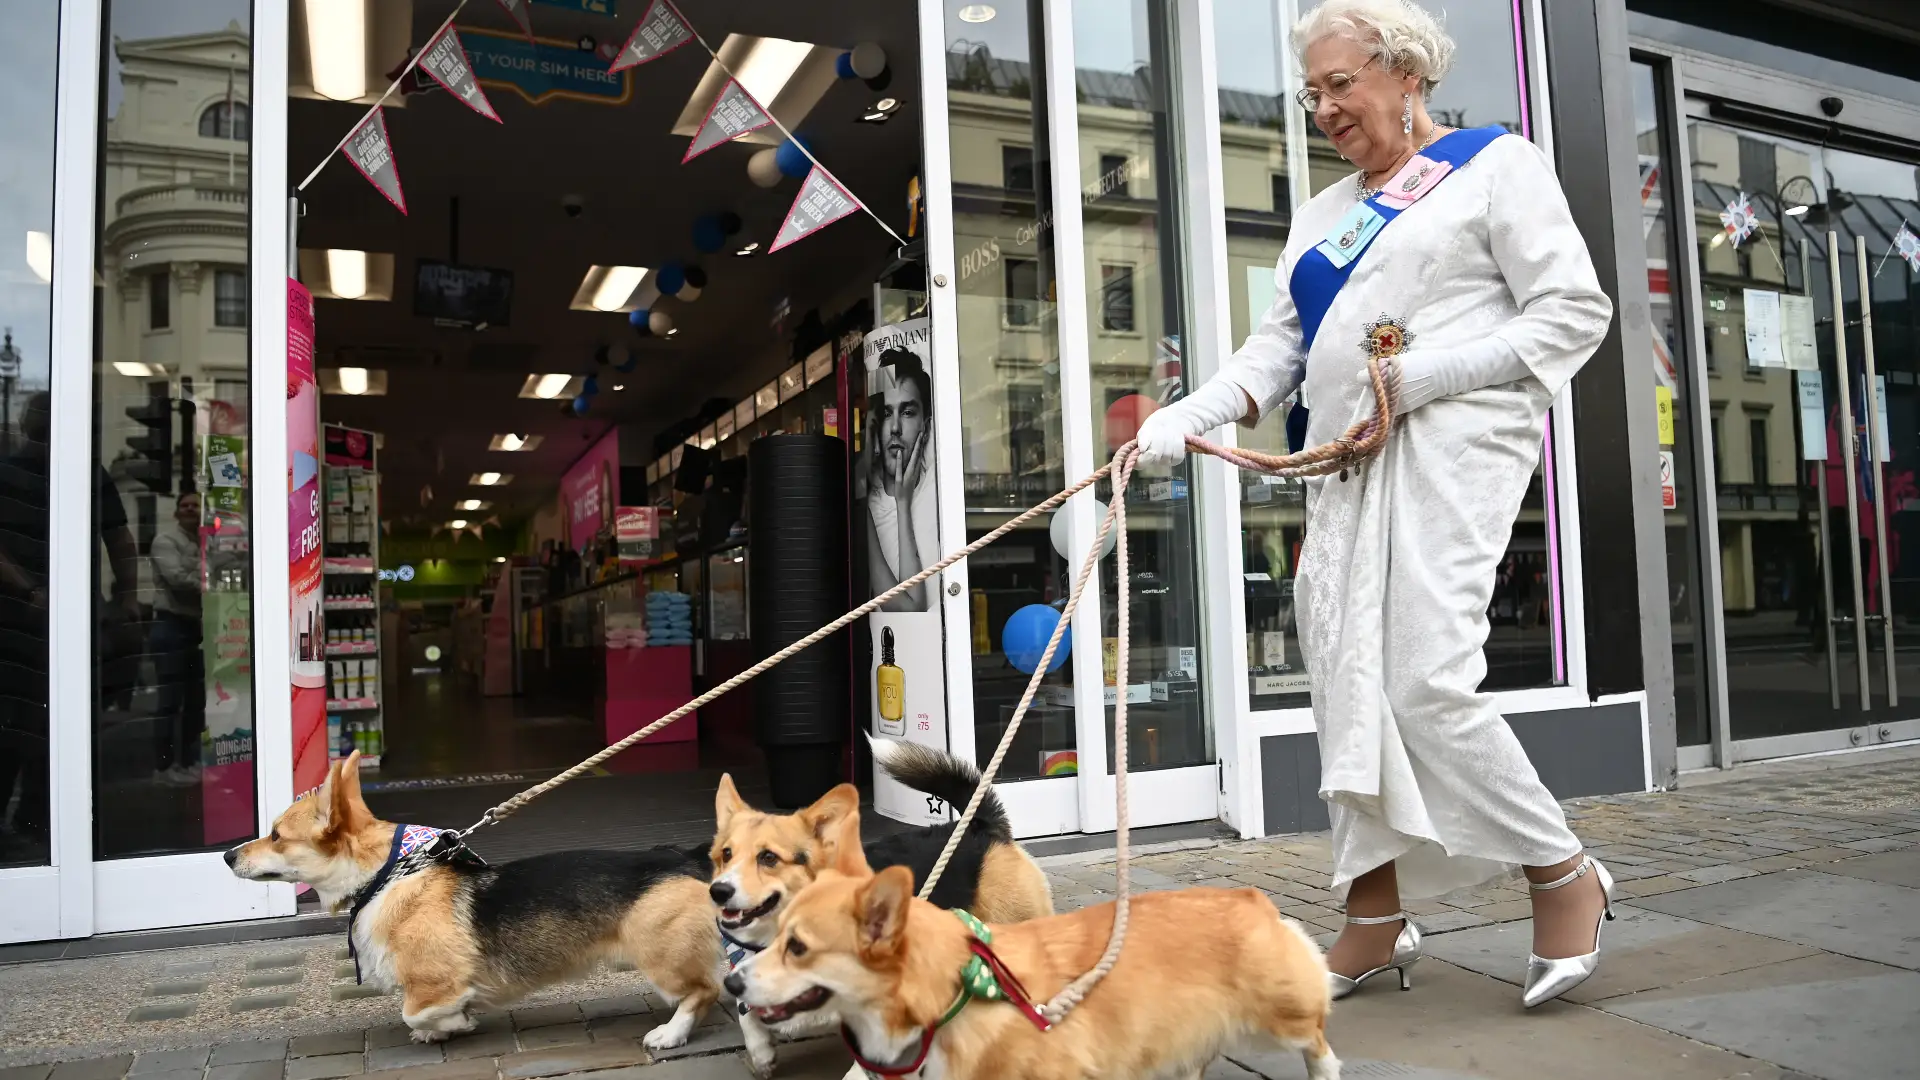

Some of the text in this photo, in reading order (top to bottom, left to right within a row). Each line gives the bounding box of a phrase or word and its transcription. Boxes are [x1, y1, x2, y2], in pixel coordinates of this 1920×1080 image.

[650, 19, 672, 42] FOR A
[654, 4, 687, 38] DEALS FIT
[641, 26, 664, 51] QUEEN
[426, 35, 455, 69] DEALS FIT
[440, 51, 459, 75] FOR A
[446, 61, 468, 87] QUEEN
[488, 53, 536, 72] YOUR
[540, 61, 569, 77] SIM
[574, 66, 618, 85] HERE
[711, 112, 736, 136] JUBILEE
[717, 102, 745, 132] PLATINUM
[360, 138, 387, 168] PLATINUM
[367, 150, 390, 176] JUBILEE
[812, 177, 849, 210] DEALS FIT
[1084, 169, 1116, 205] PERFECT
[800, 199, 825, 223] QUEEN
[809, 191, 833, 214] FOR A
[1016, 221, 1042, 246] Calvin
[961, 236, 1000, 280] BOSS
[887, 327, 927, 350] ARMANI
[310, 489, 319, 517] Ge
[301, 519, 320, 558] FREE
[882, 686, 897, 699] YOU
[917, 721, 929, 731] £75
[216, 737, 252, 756] DOING GO
